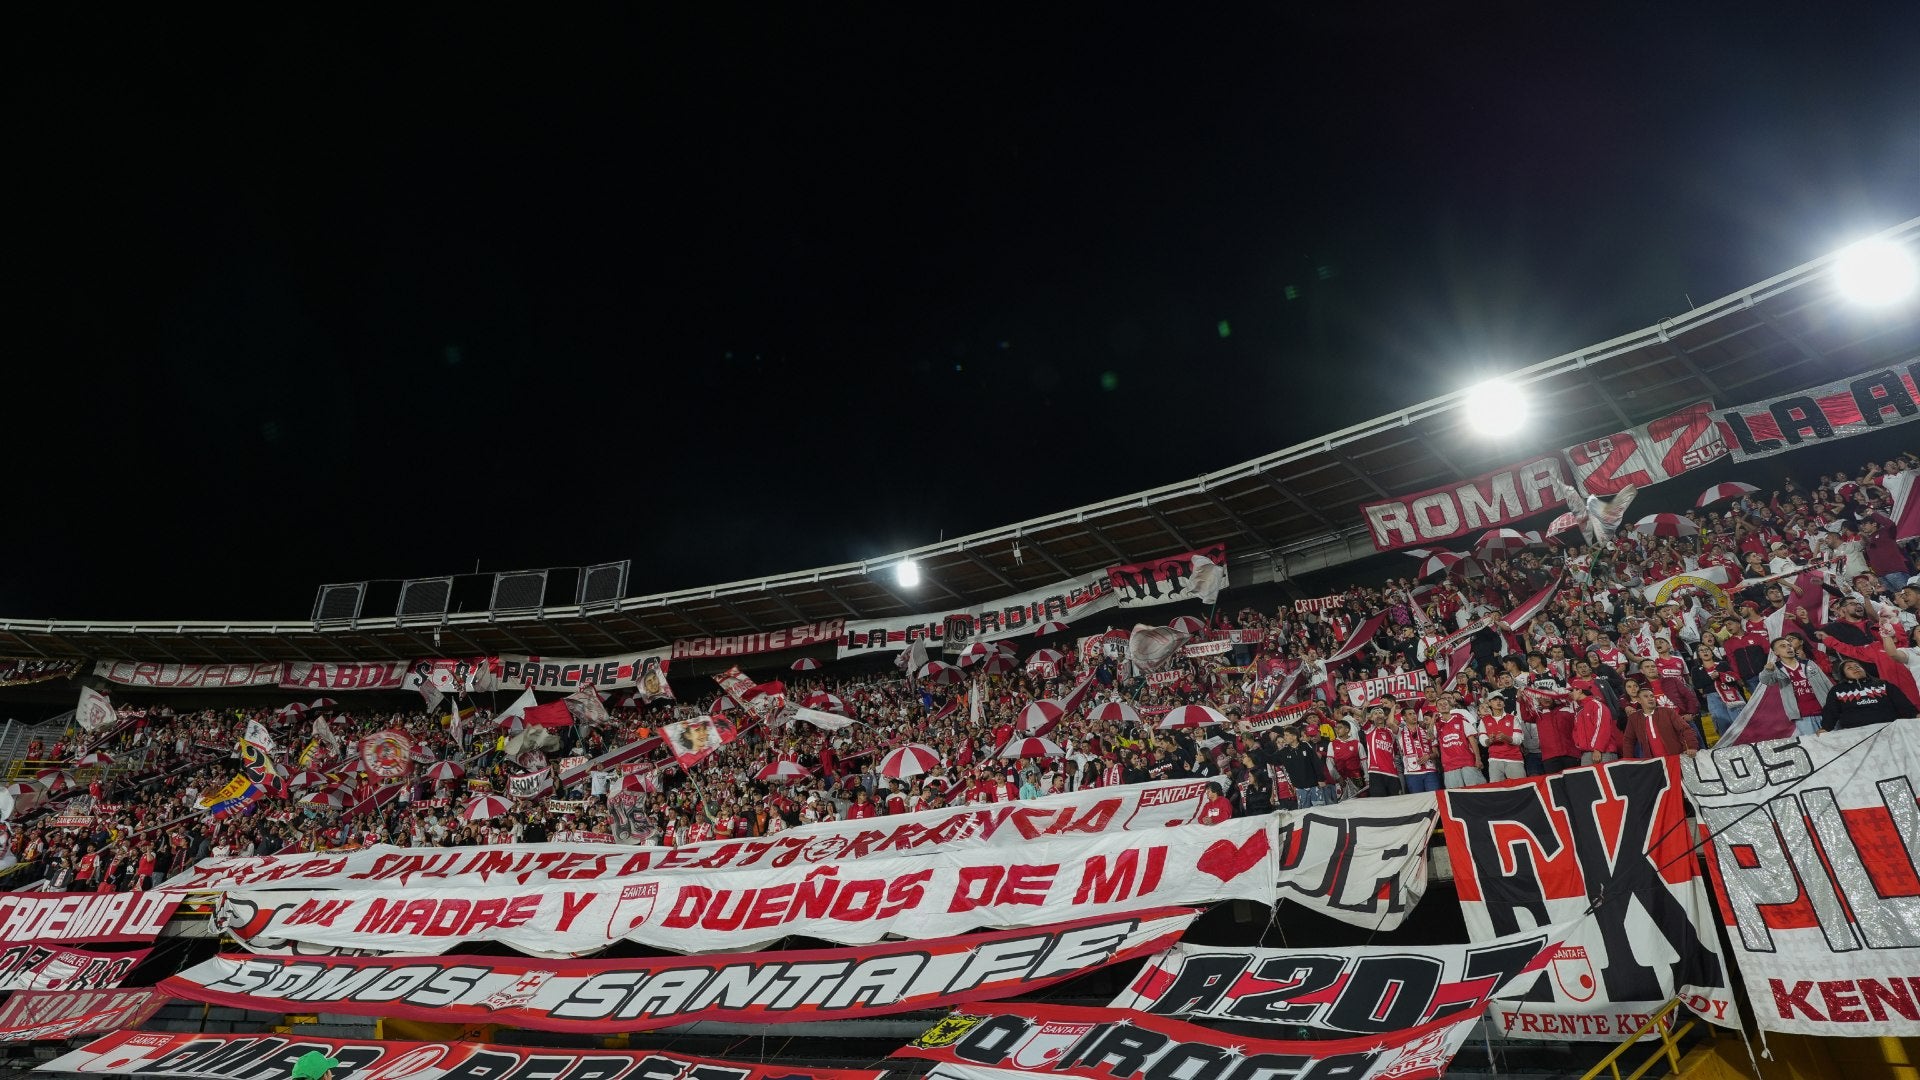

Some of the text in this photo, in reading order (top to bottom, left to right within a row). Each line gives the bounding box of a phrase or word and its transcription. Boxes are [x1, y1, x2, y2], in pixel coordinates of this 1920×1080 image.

[1723, 363, 1920, 456] LA A
[1682, 440, 1729, 470] SUR
[1365, 456, 1567, 547] ROMA
[1294, 594, 1345, 614] CRITTERS
[673, 617, 845, 659] AGUANTE SUR
[847, 628, 887, 650] LA
[107, 660, 279, 688] CRUZADA
[502, 660, 620, 687] PARCHE
[1366, 671, 1429, 702] BRITALIA
[1856, 698, 1878, 706] adidas
[1250, 713, 1275, 728] GRAN
[1679, 736, 1815, 797] LOS
[282, 897, 355, 928] MI
[352, 893, 544, 937] MADRE
[554, 891, 599, 932] Y
[660, 865, 935, 932] DUEÑOS
[946, 863, 1060, 914] DE
[1071, 845, 1169, 906] MI
[1445, 757, 1726, 1003] FK
[119, 892, 188, 936] DC
[204, 917, 1142, 1021] SOMOS SANTA FE
[1042, 1024, 1088, 1035] SANTA FE
[1501, 1011, 1611, 1036] FRENTE
